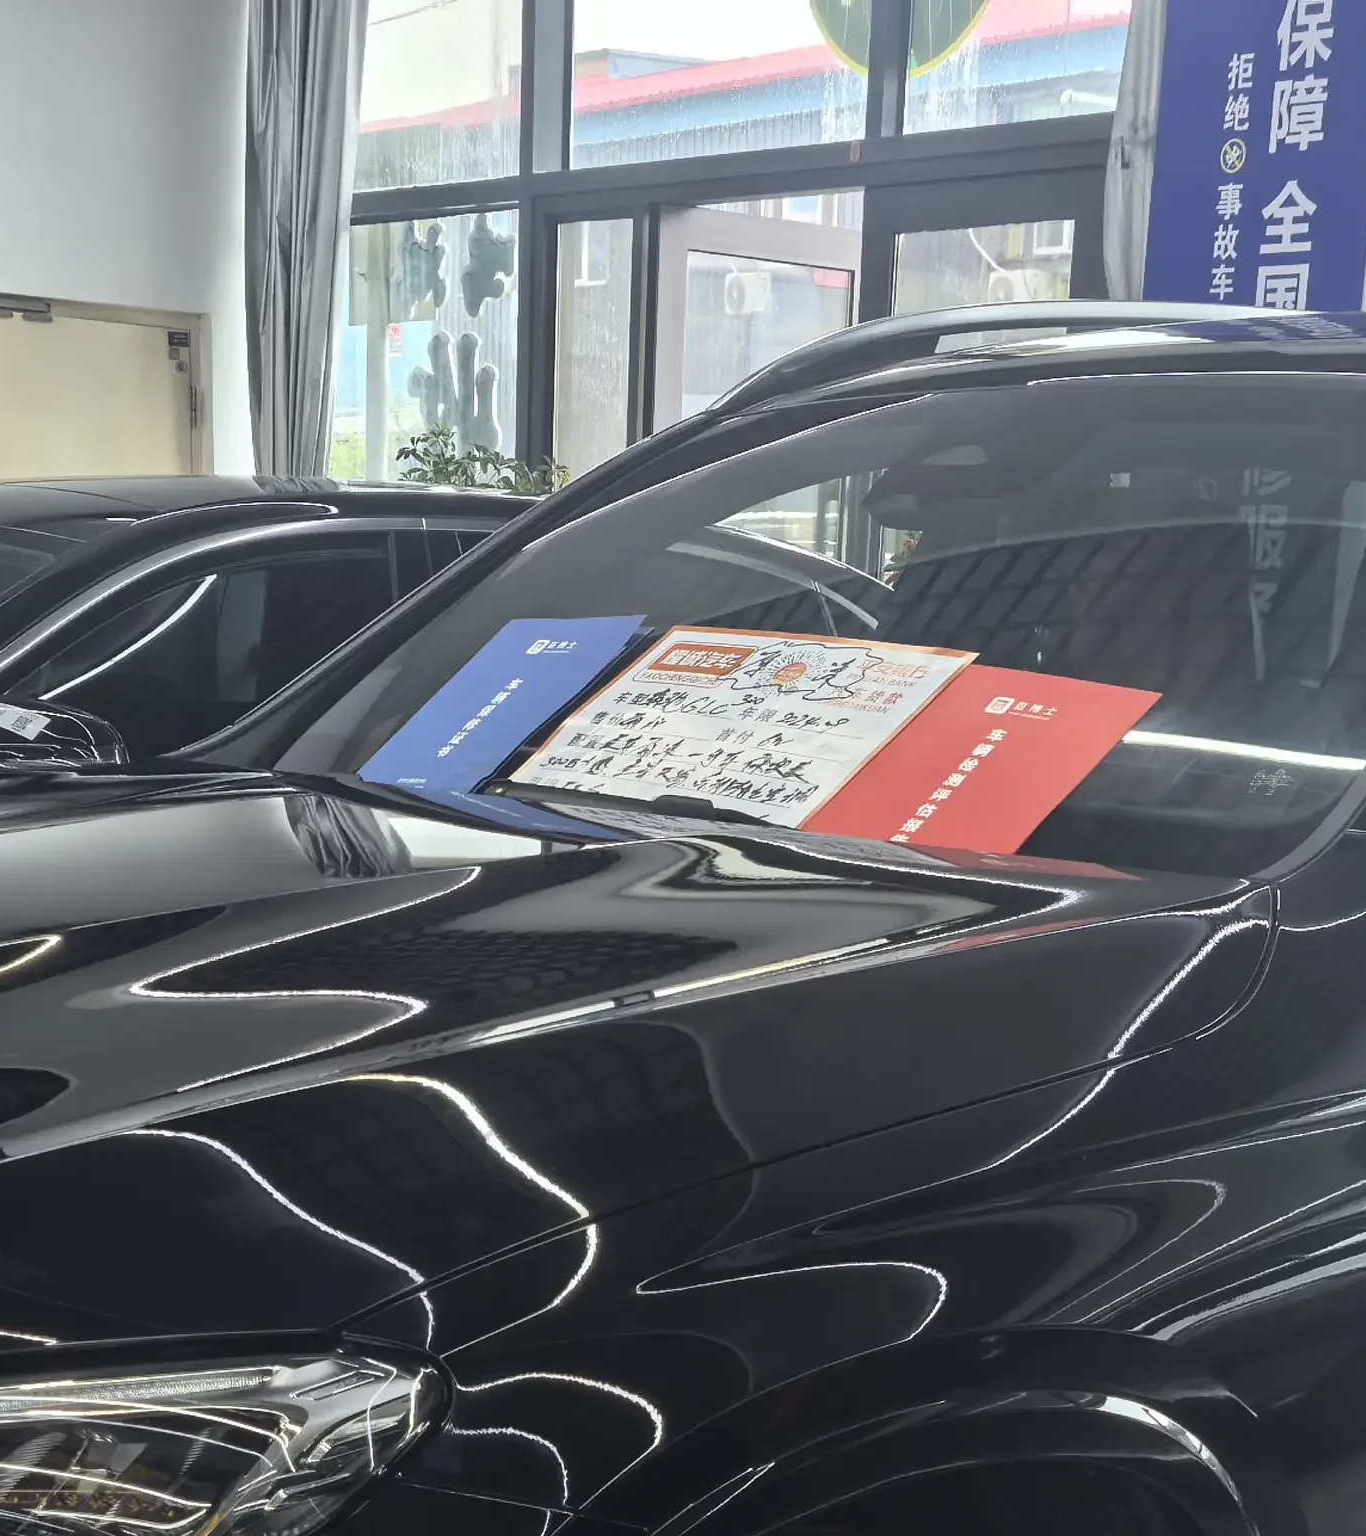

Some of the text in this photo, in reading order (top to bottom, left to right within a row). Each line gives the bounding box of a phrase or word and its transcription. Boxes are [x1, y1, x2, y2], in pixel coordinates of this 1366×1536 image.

[1209, 52, 1255, 301] 拒绝 事故车
